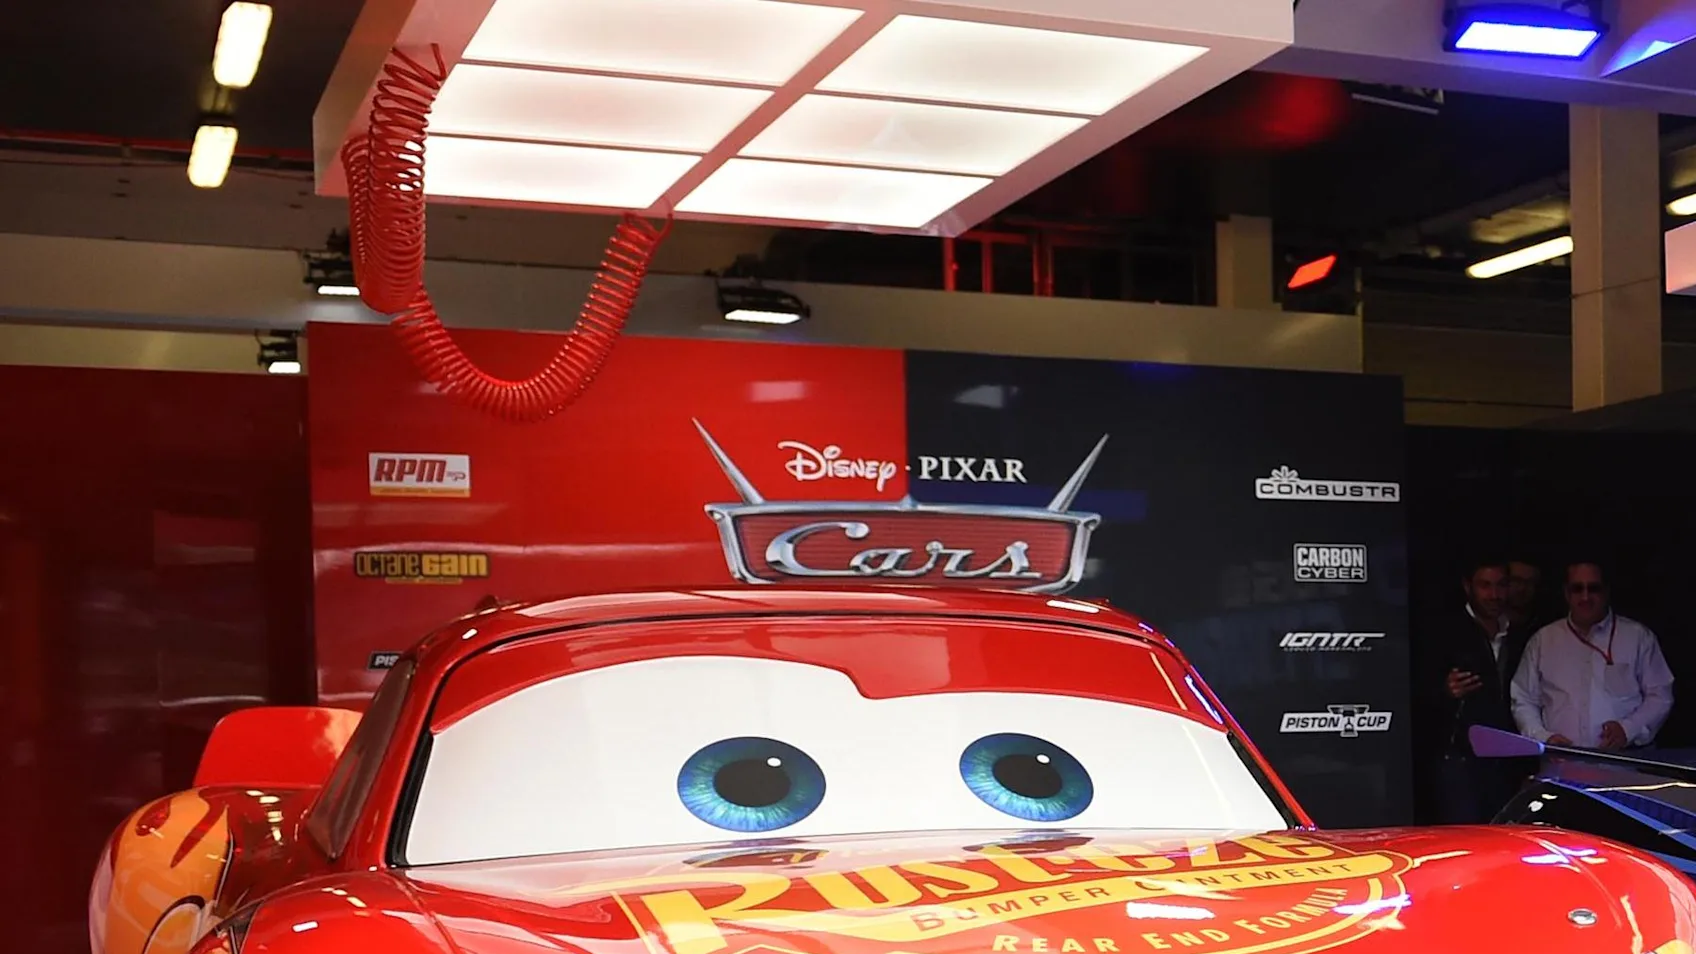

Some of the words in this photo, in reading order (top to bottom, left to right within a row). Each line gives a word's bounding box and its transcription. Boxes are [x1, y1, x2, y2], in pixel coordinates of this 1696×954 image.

[374, 458, 447, 483] RPM
[918, 457, 1027, 484] PIXAR
[1259, 482, 1397, 499] COMBUSTR
[765, 521, 1043, 579] Cars
[1297, 547, 1364, 567] CARBON
[1297, 567, 1364, 579] CYBER
[1279, 632, 1386, 648] IGNTR
[1285, 716, 1342, 729] PISTON
[1357, 715, 1388, 728] CUP
[909, 886, 1111, 932] BUMPER
[992, 934, 1121, 954] REAR
[1140, 928, 1231, 951] END
